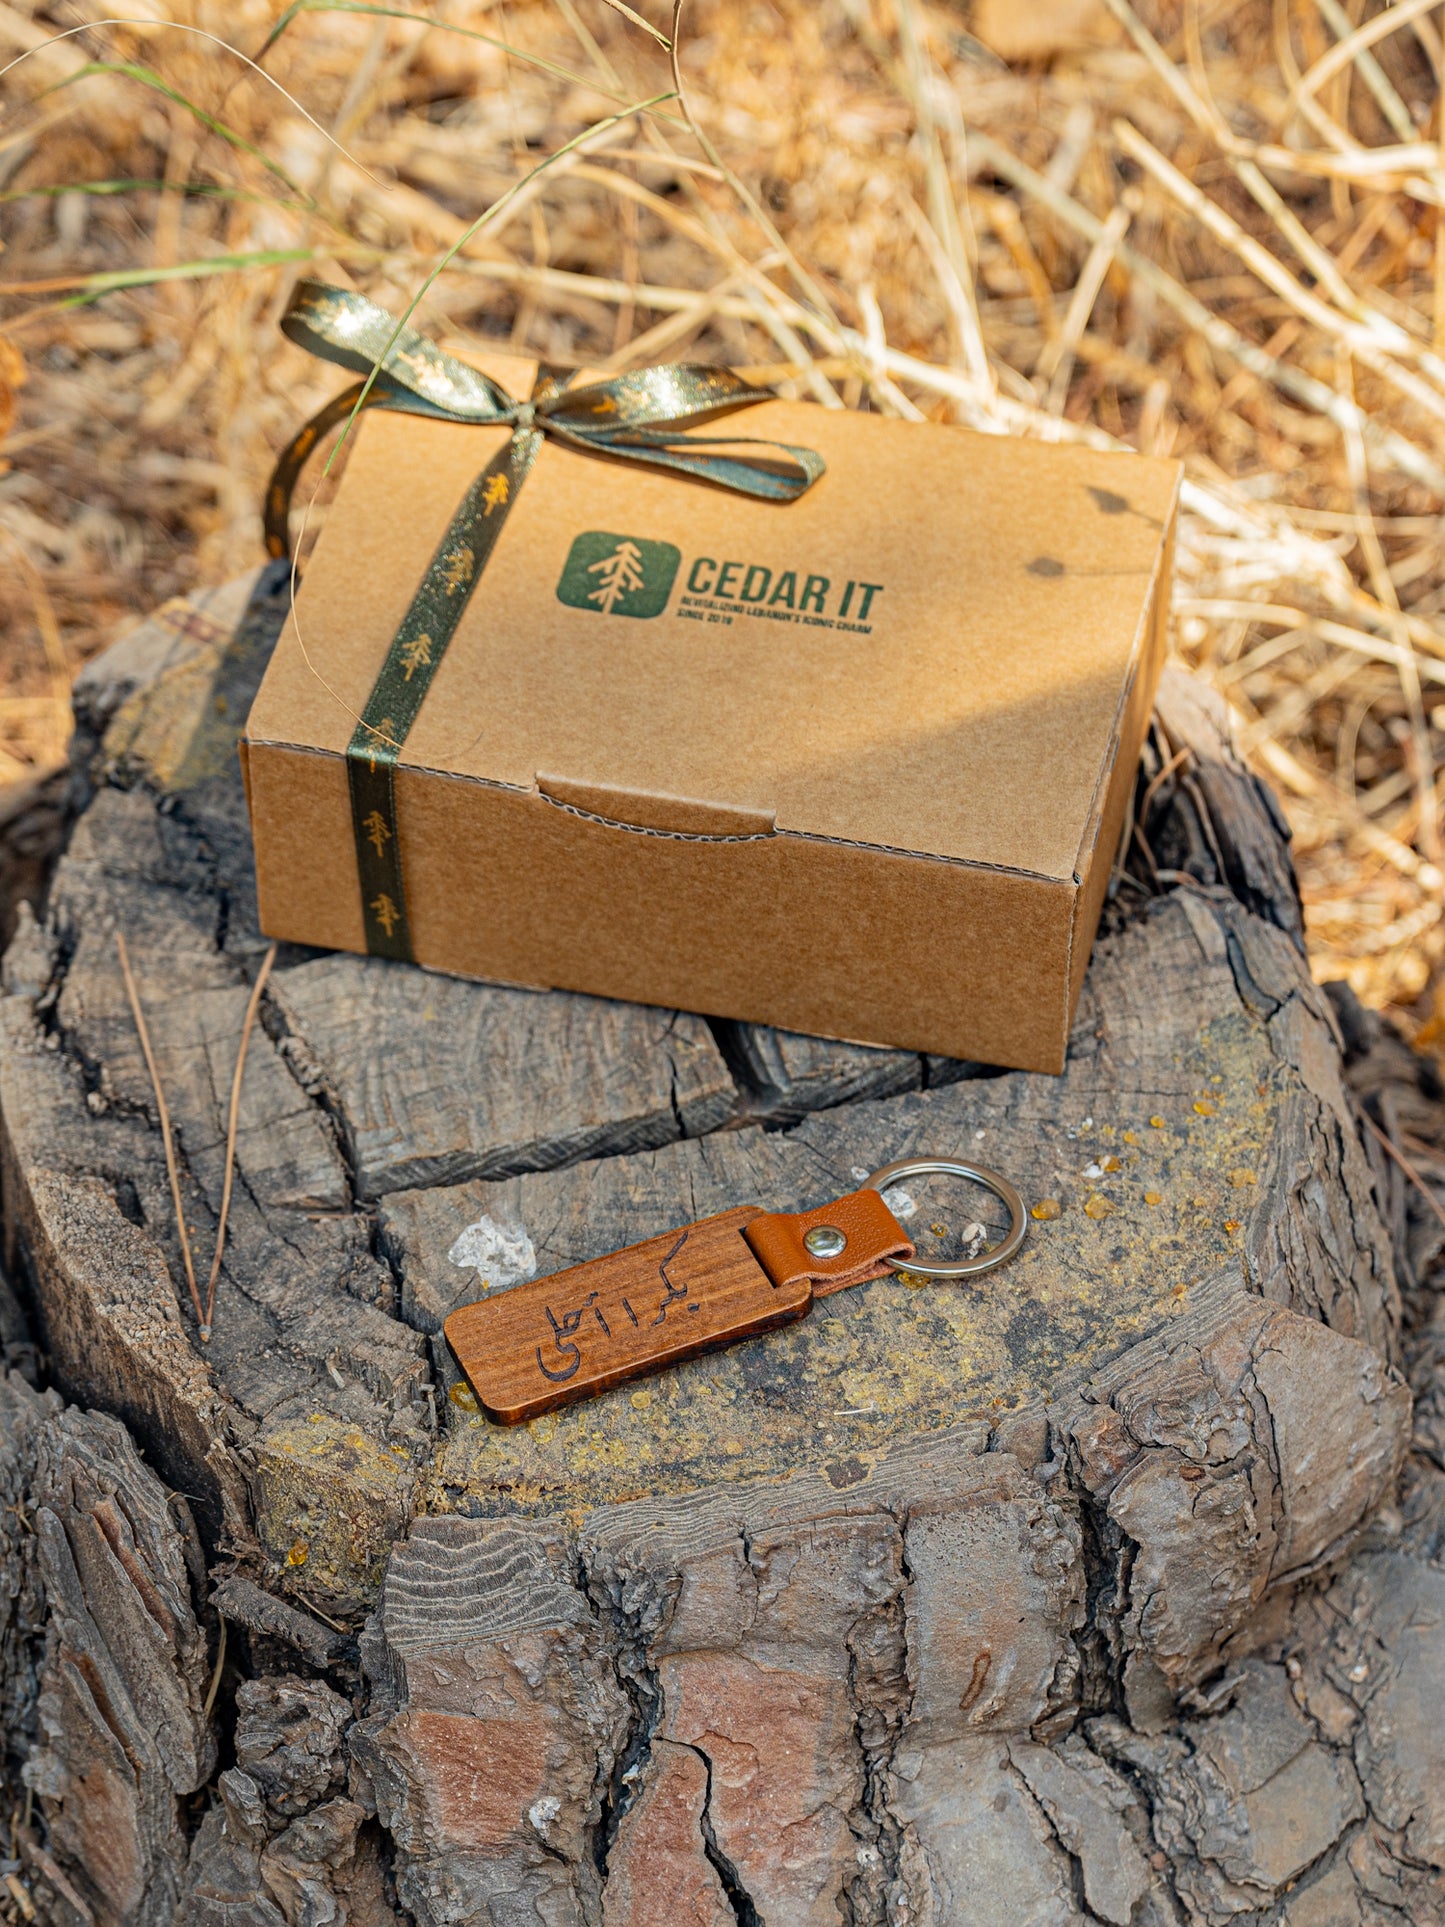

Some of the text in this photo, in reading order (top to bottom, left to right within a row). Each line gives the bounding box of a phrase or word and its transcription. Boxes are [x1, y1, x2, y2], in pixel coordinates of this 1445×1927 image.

[686, 557, 884, 620] CEDAR IT
[677, 607, 704, 620] SINCE
[747, 605, 800, 624] LEBANON'S
[802, 615, 835, 629] ICONIC
[836, 621, 872, 634] CHARM
